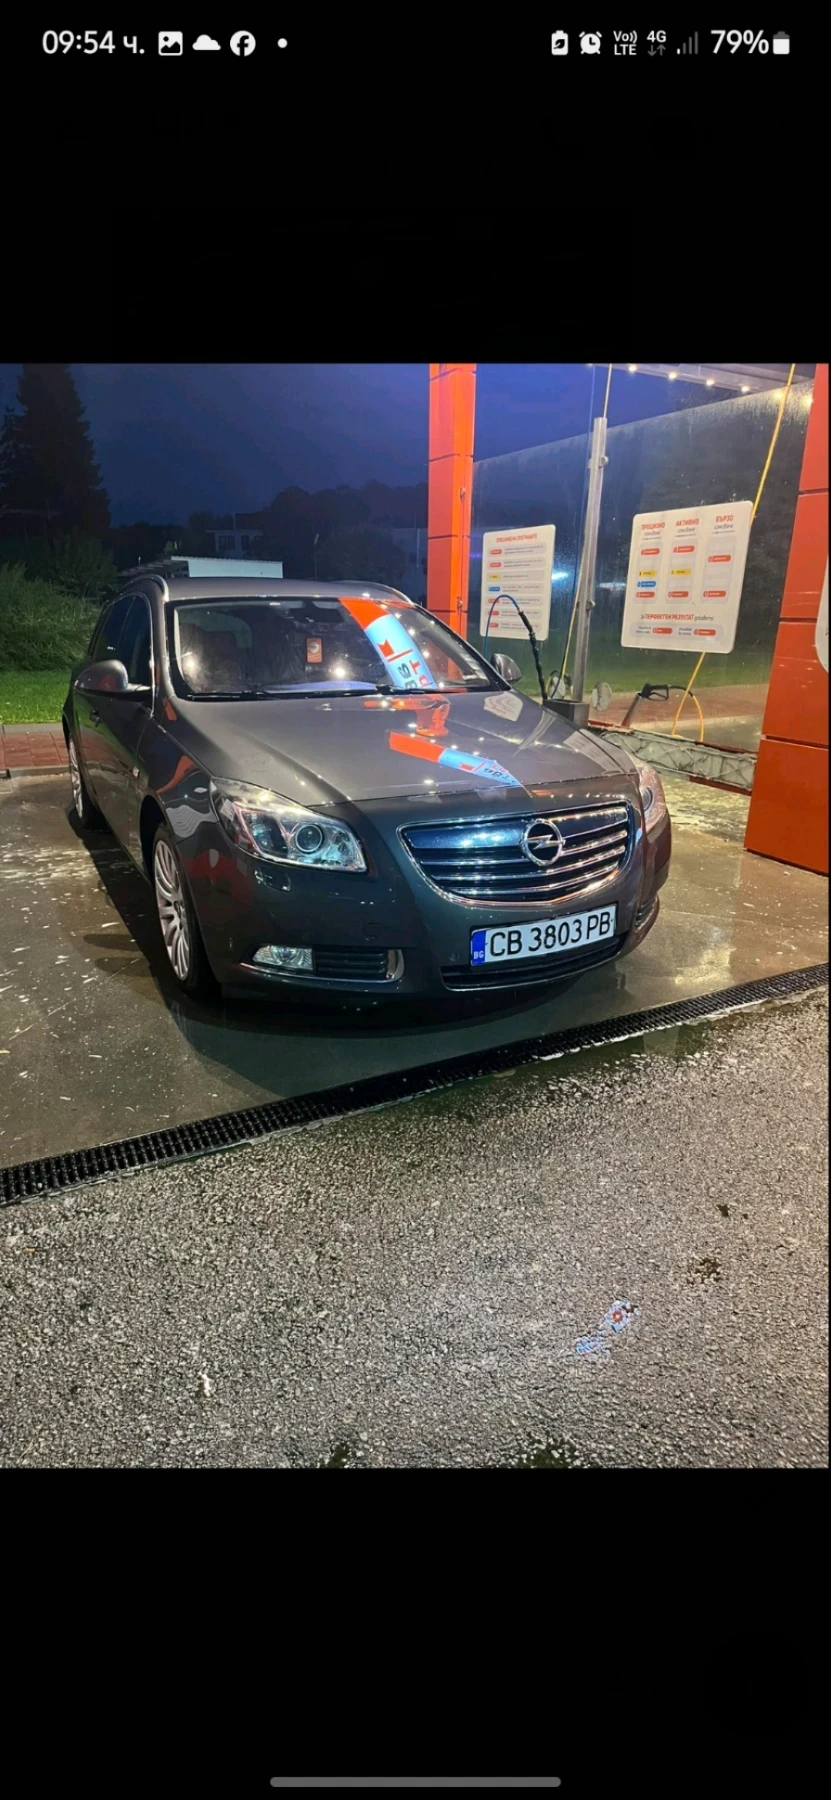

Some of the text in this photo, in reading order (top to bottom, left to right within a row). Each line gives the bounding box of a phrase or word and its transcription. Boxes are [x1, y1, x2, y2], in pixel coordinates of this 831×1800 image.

[675, 518, 699, 527] АКТИВНО
[715, 515, 734, 523] БЪРЗО
[490, 911, 611, 957] CB 3803 PB
[473, 950, 485, 959] BG
